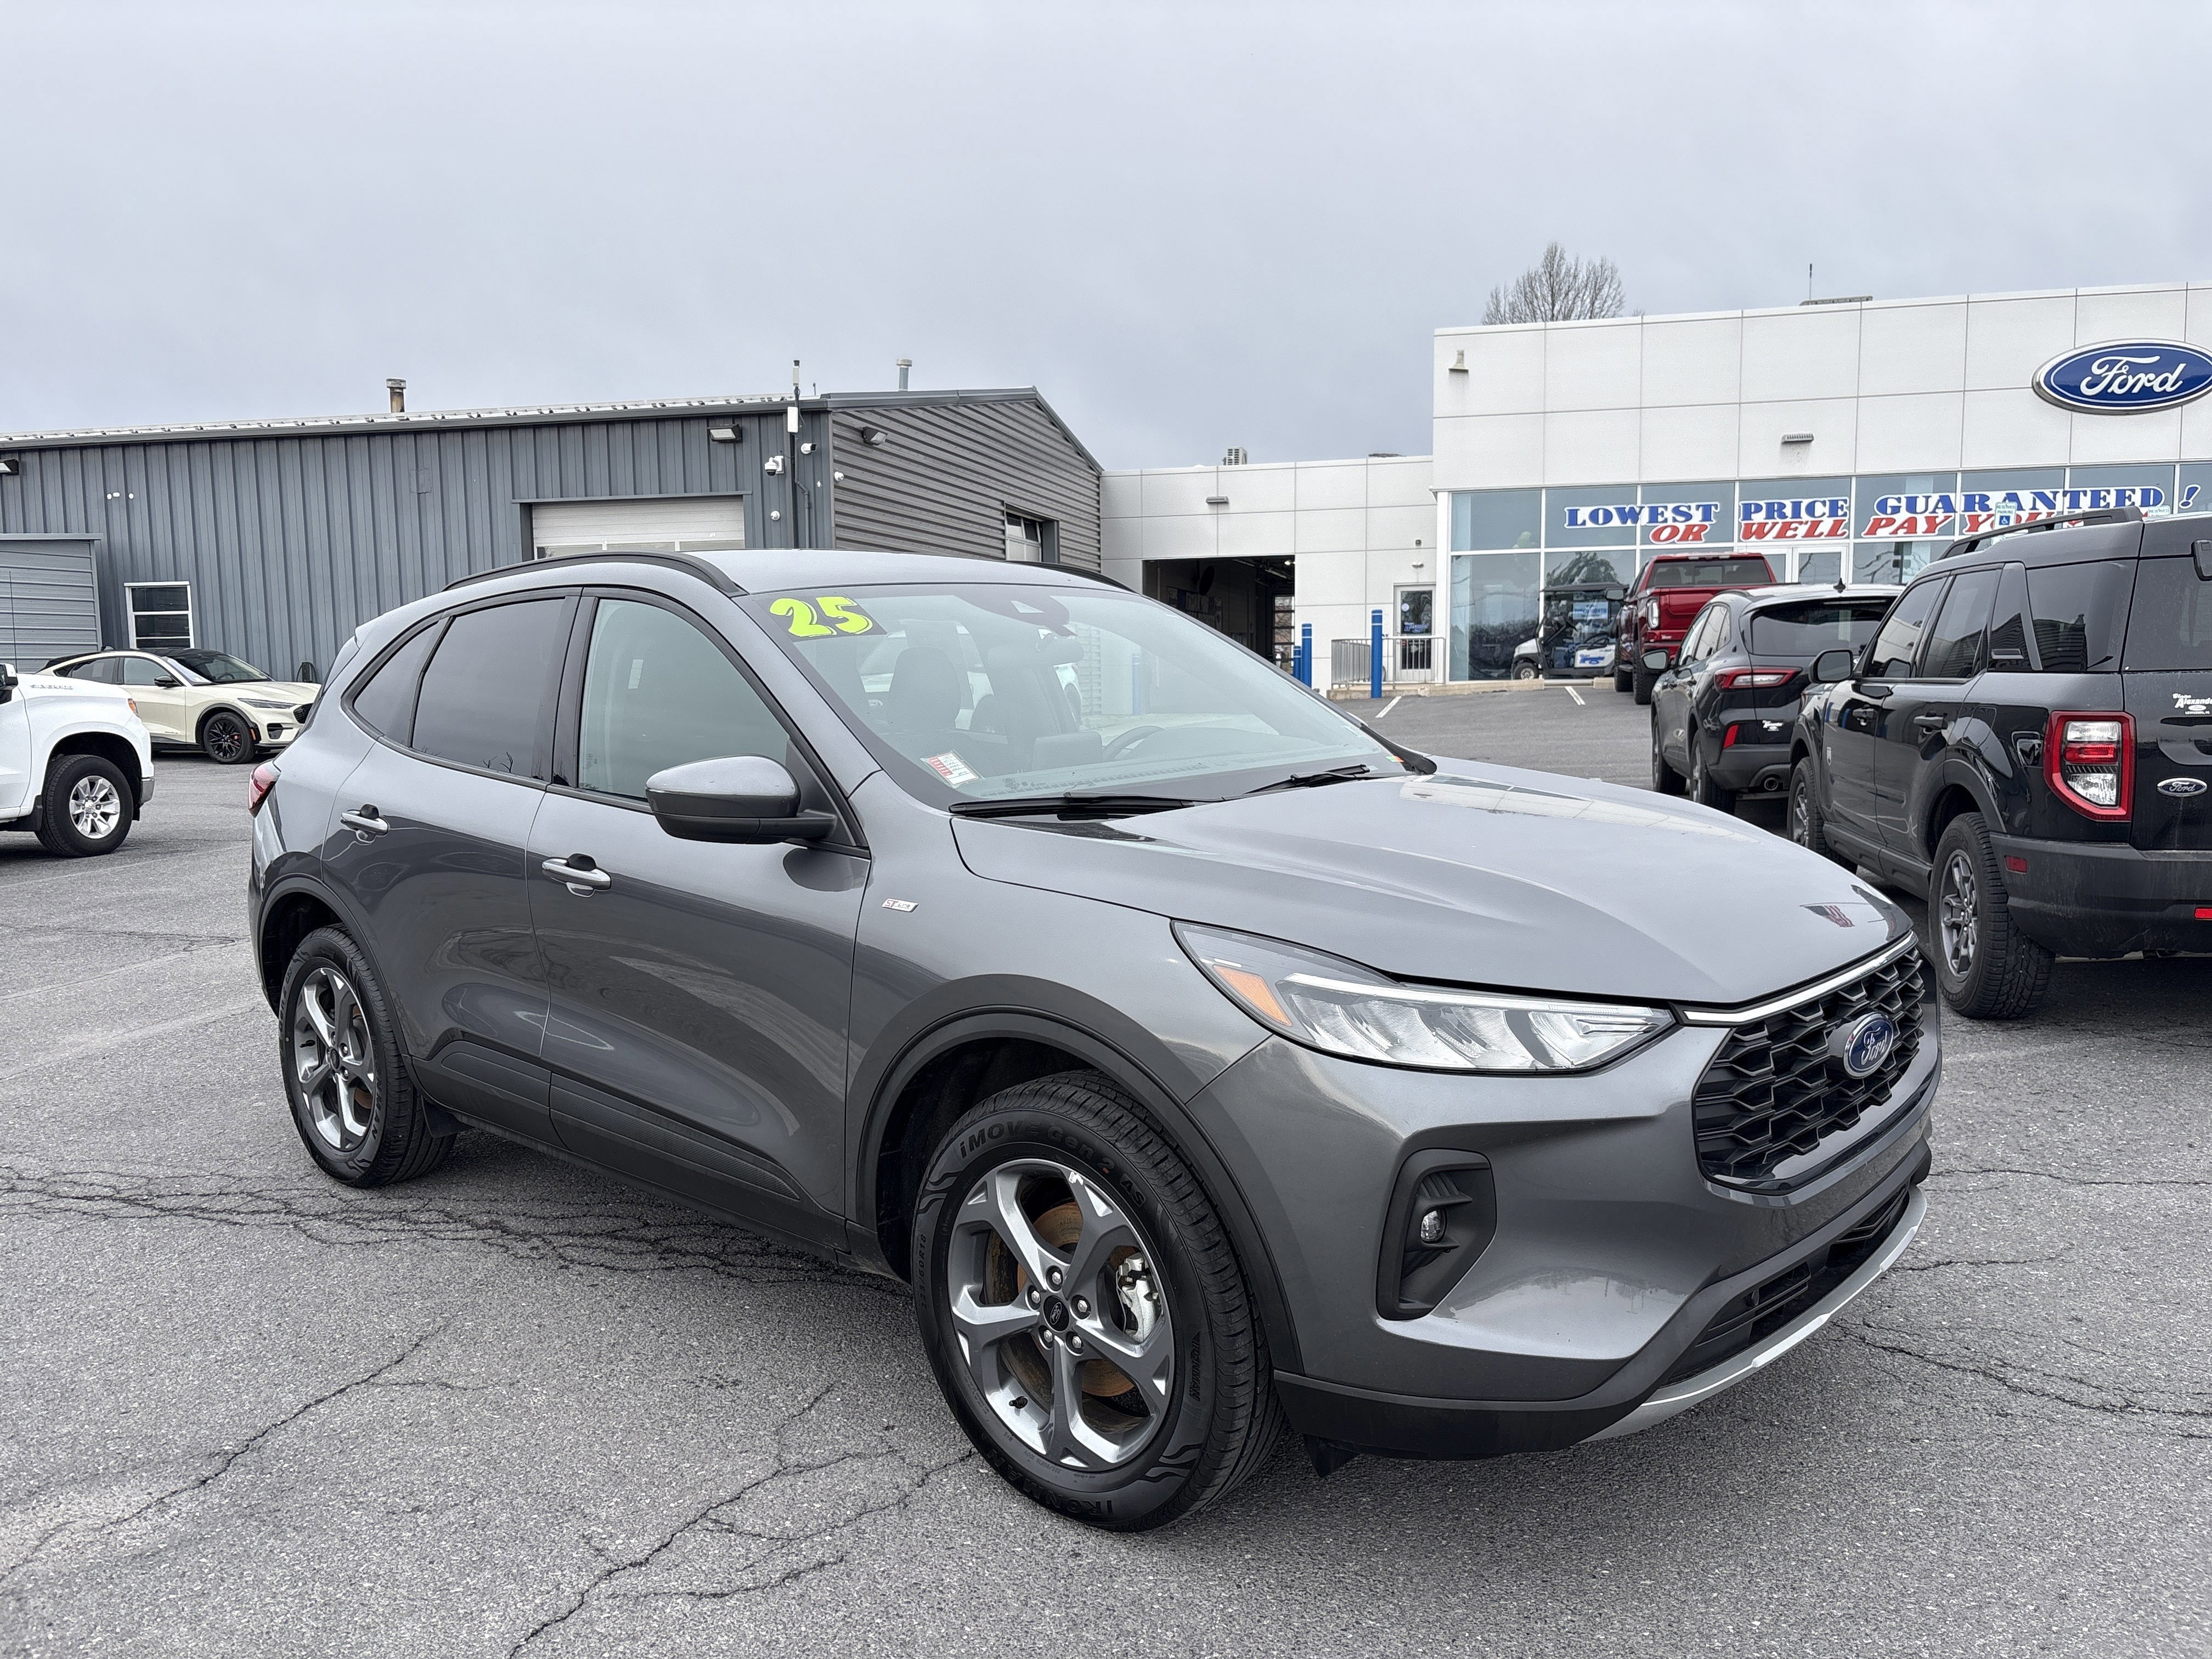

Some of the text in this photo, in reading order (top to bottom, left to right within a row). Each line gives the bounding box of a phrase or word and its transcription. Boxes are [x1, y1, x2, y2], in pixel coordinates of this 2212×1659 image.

[2080, 356, 2187, 396] Ford
[1566, 503, 1718, 527] LOWEST
[1741, 499, 1847, 521] PRICE
[1876, 488, 2163, 515] GUARANTEED
[1651, 524, 1708, 542] OR
[1741, 519, 1847, 540] WE'LL
[1864, 515, 1953, 535] PAY
[770, 596, 873, 637] 25
[2169, 781, 2196, 792] Ford
[1861, 1026, 1888, 1065] Ford
[1047, 1126, 1096, 1160] Gen
[1098, 1157, 1115, 1175] 2
[918, 1234, 927, 1309] 225/60R18
[989, 1449, 1114, 1515] IRONMAN
[1036, 1459, 1062, 1474] 225/60R18
